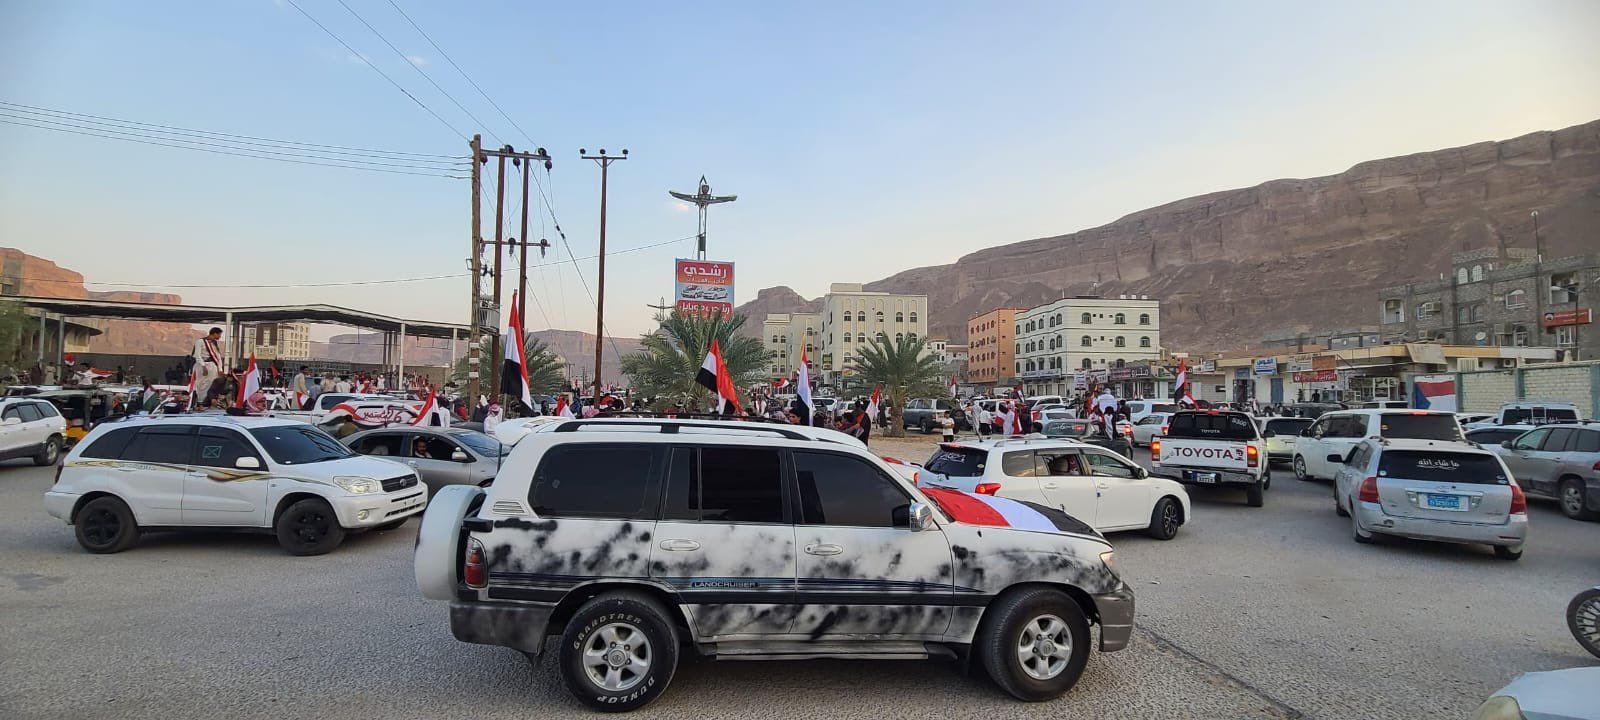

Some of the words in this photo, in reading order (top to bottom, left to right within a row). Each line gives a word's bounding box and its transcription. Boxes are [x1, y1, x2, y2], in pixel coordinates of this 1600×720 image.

[683, 264, 727, 279] رشدي
[1173, 447, 1234, 460] TOYOTA
[596, 676, 655, 704] DUNLOP
